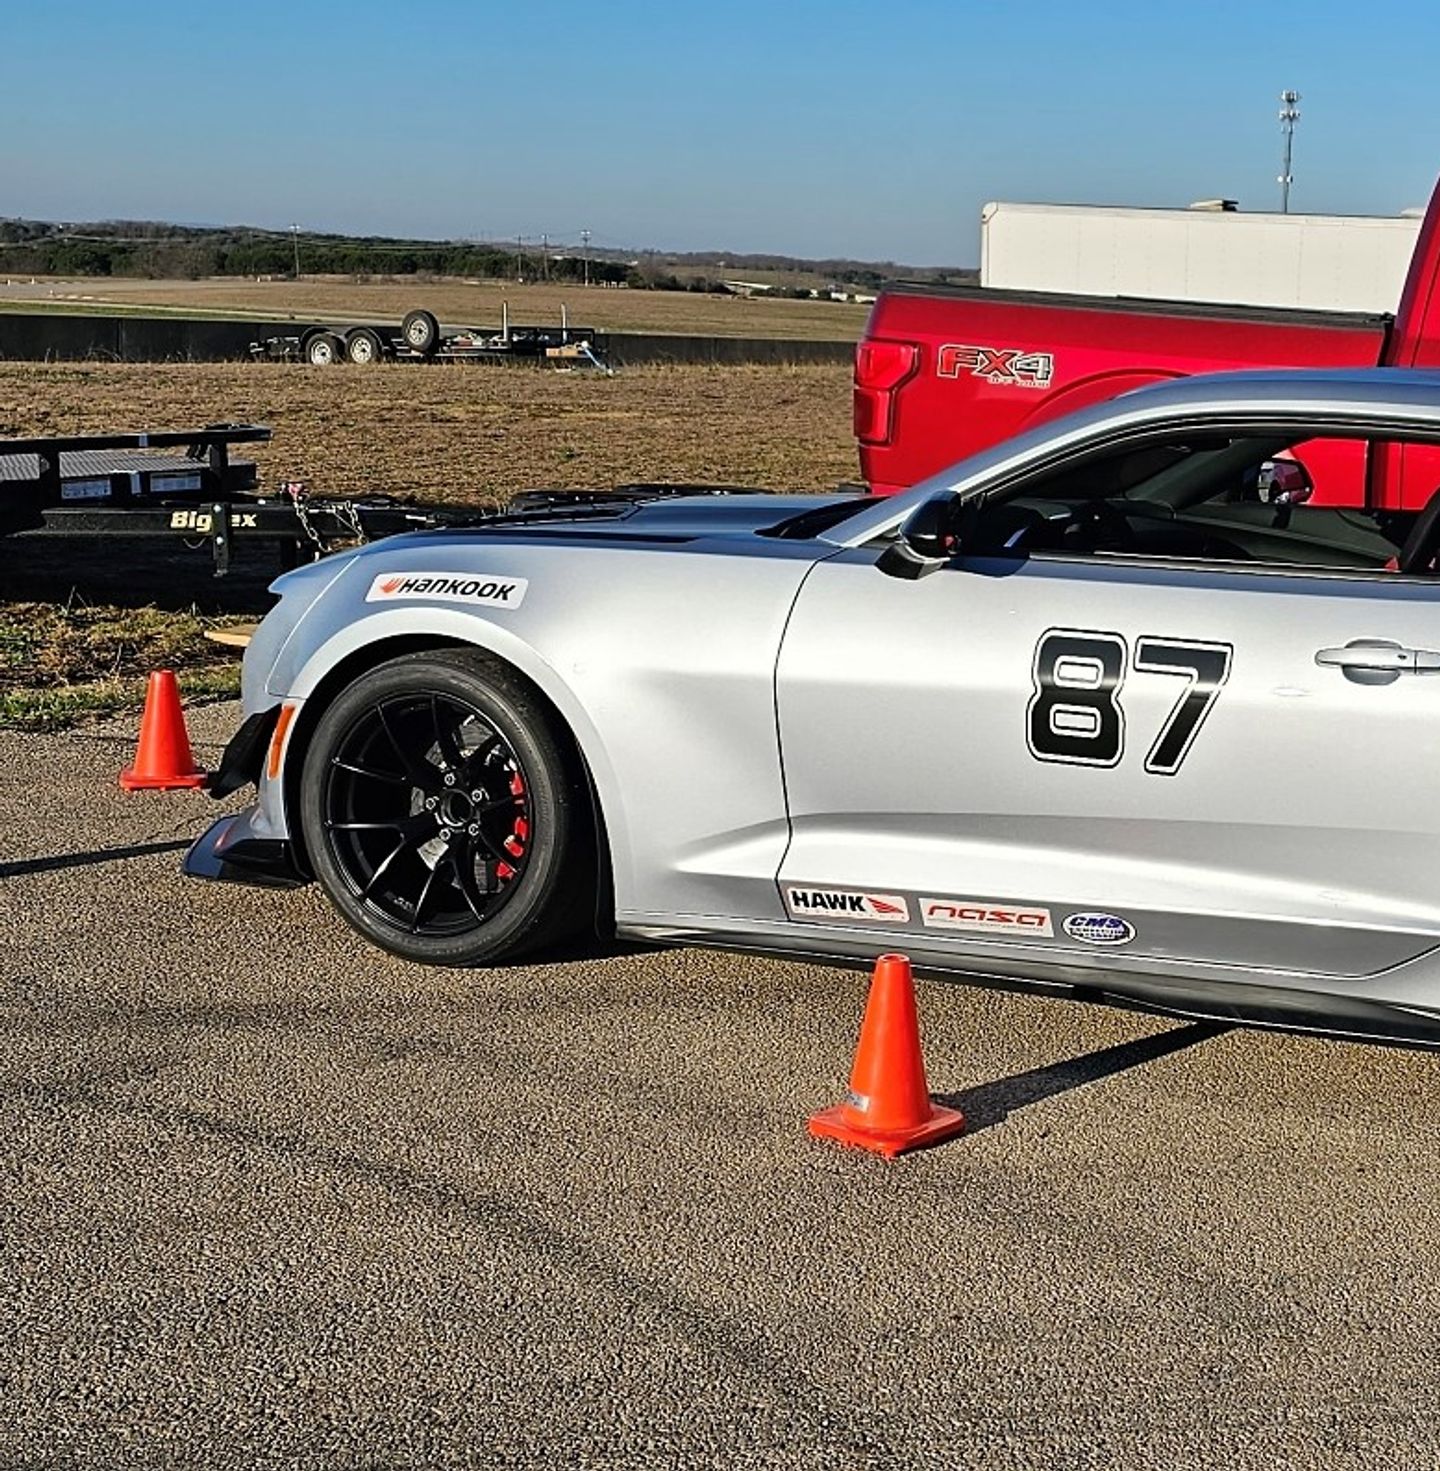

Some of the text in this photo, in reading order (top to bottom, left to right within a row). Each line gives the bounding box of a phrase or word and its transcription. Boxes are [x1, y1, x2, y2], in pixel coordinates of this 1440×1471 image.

[937, 344, 1054, 381] FX4
[171, 510, 257, 533] Big ex
[1025, 626, 1234, 777] 87
[791, 890, 867, 912] HAWK
[1069, 916, 1124, 928] CMS
